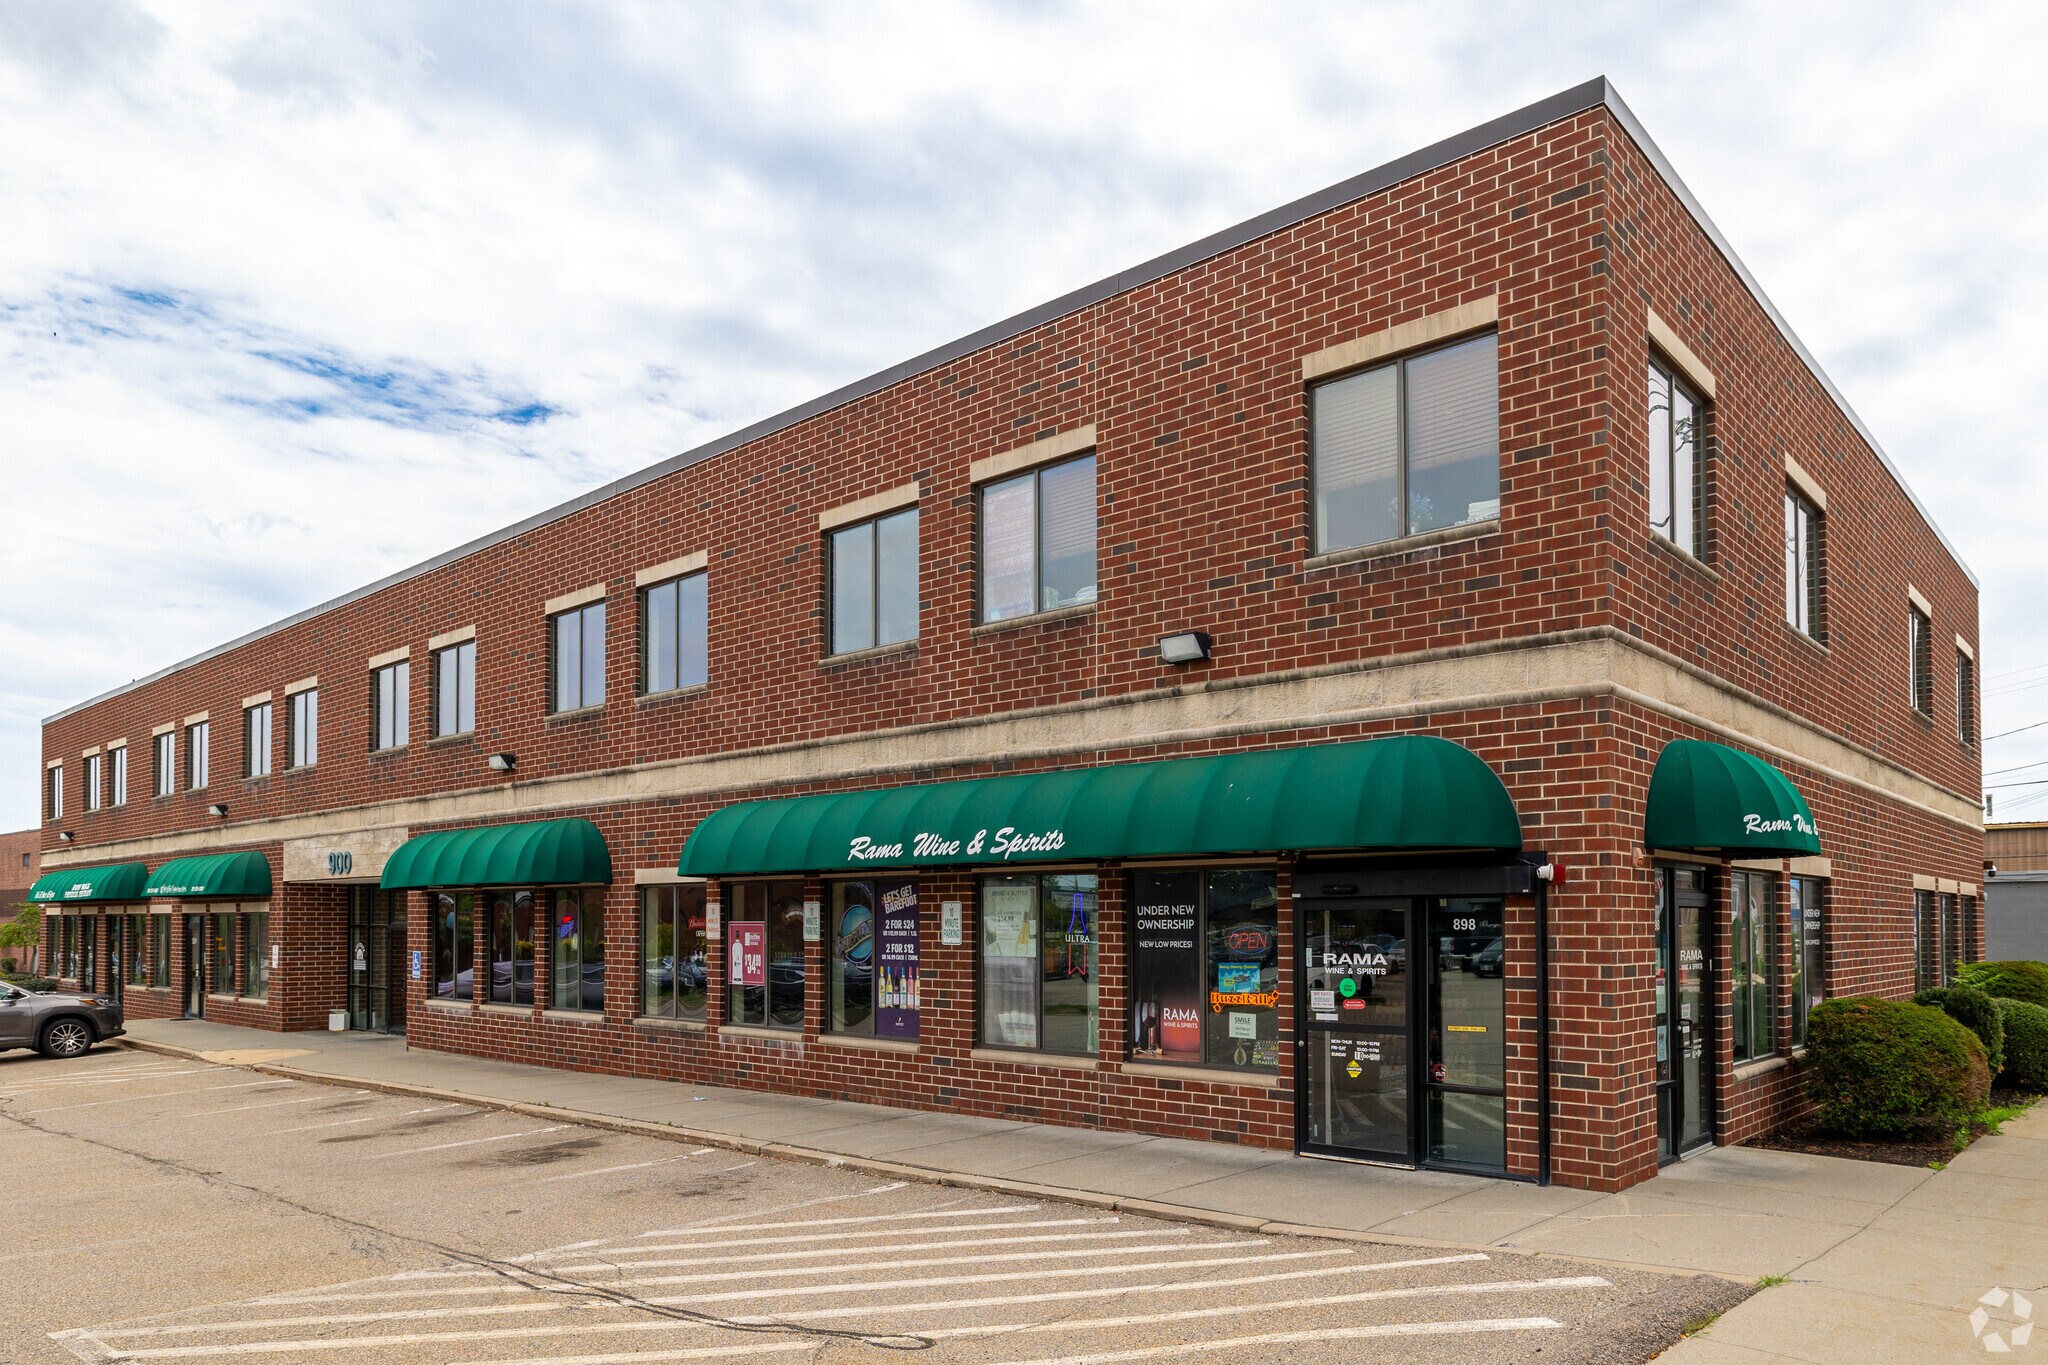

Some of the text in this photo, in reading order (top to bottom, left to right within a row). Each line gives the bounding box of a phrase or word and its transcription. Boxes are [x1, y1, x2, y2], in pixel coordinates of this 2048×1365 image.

[1743, 814, 1792, 835] Rama
[848, 827, 1066, 861] Rama Wine & Spirits
[328, 851, 352, 875] 900
[883, 885, 913, 904] LET'S GET
[884, 894, 917, 914] BAREFOOT
[1137, 905, 1195, 916] UNDER NEW
[885, 920, 915, 929] 2 FOR $24
[944, 918, 959, 928] MINUTE
[1137, 919, 1195, 930] OWNERSHIP
[1452, 918, 1476, 931] 898
[804, 926, 818, 935] PARKING
[944, 929, 960, 938] PARKING
[1065, 934, 1090, 942] ULTRA
[1229, 932, 1267, 949] OPEN
[886, 944, 914, 953] 2 FOR $12
[1323, 953, 1387, 965] RAMA
[1680, 949, 1703, 961] RAMA
[1356, 967, 1387, 975] SPIRITS
[1163, 1007, 1198, 1021] RAMA
